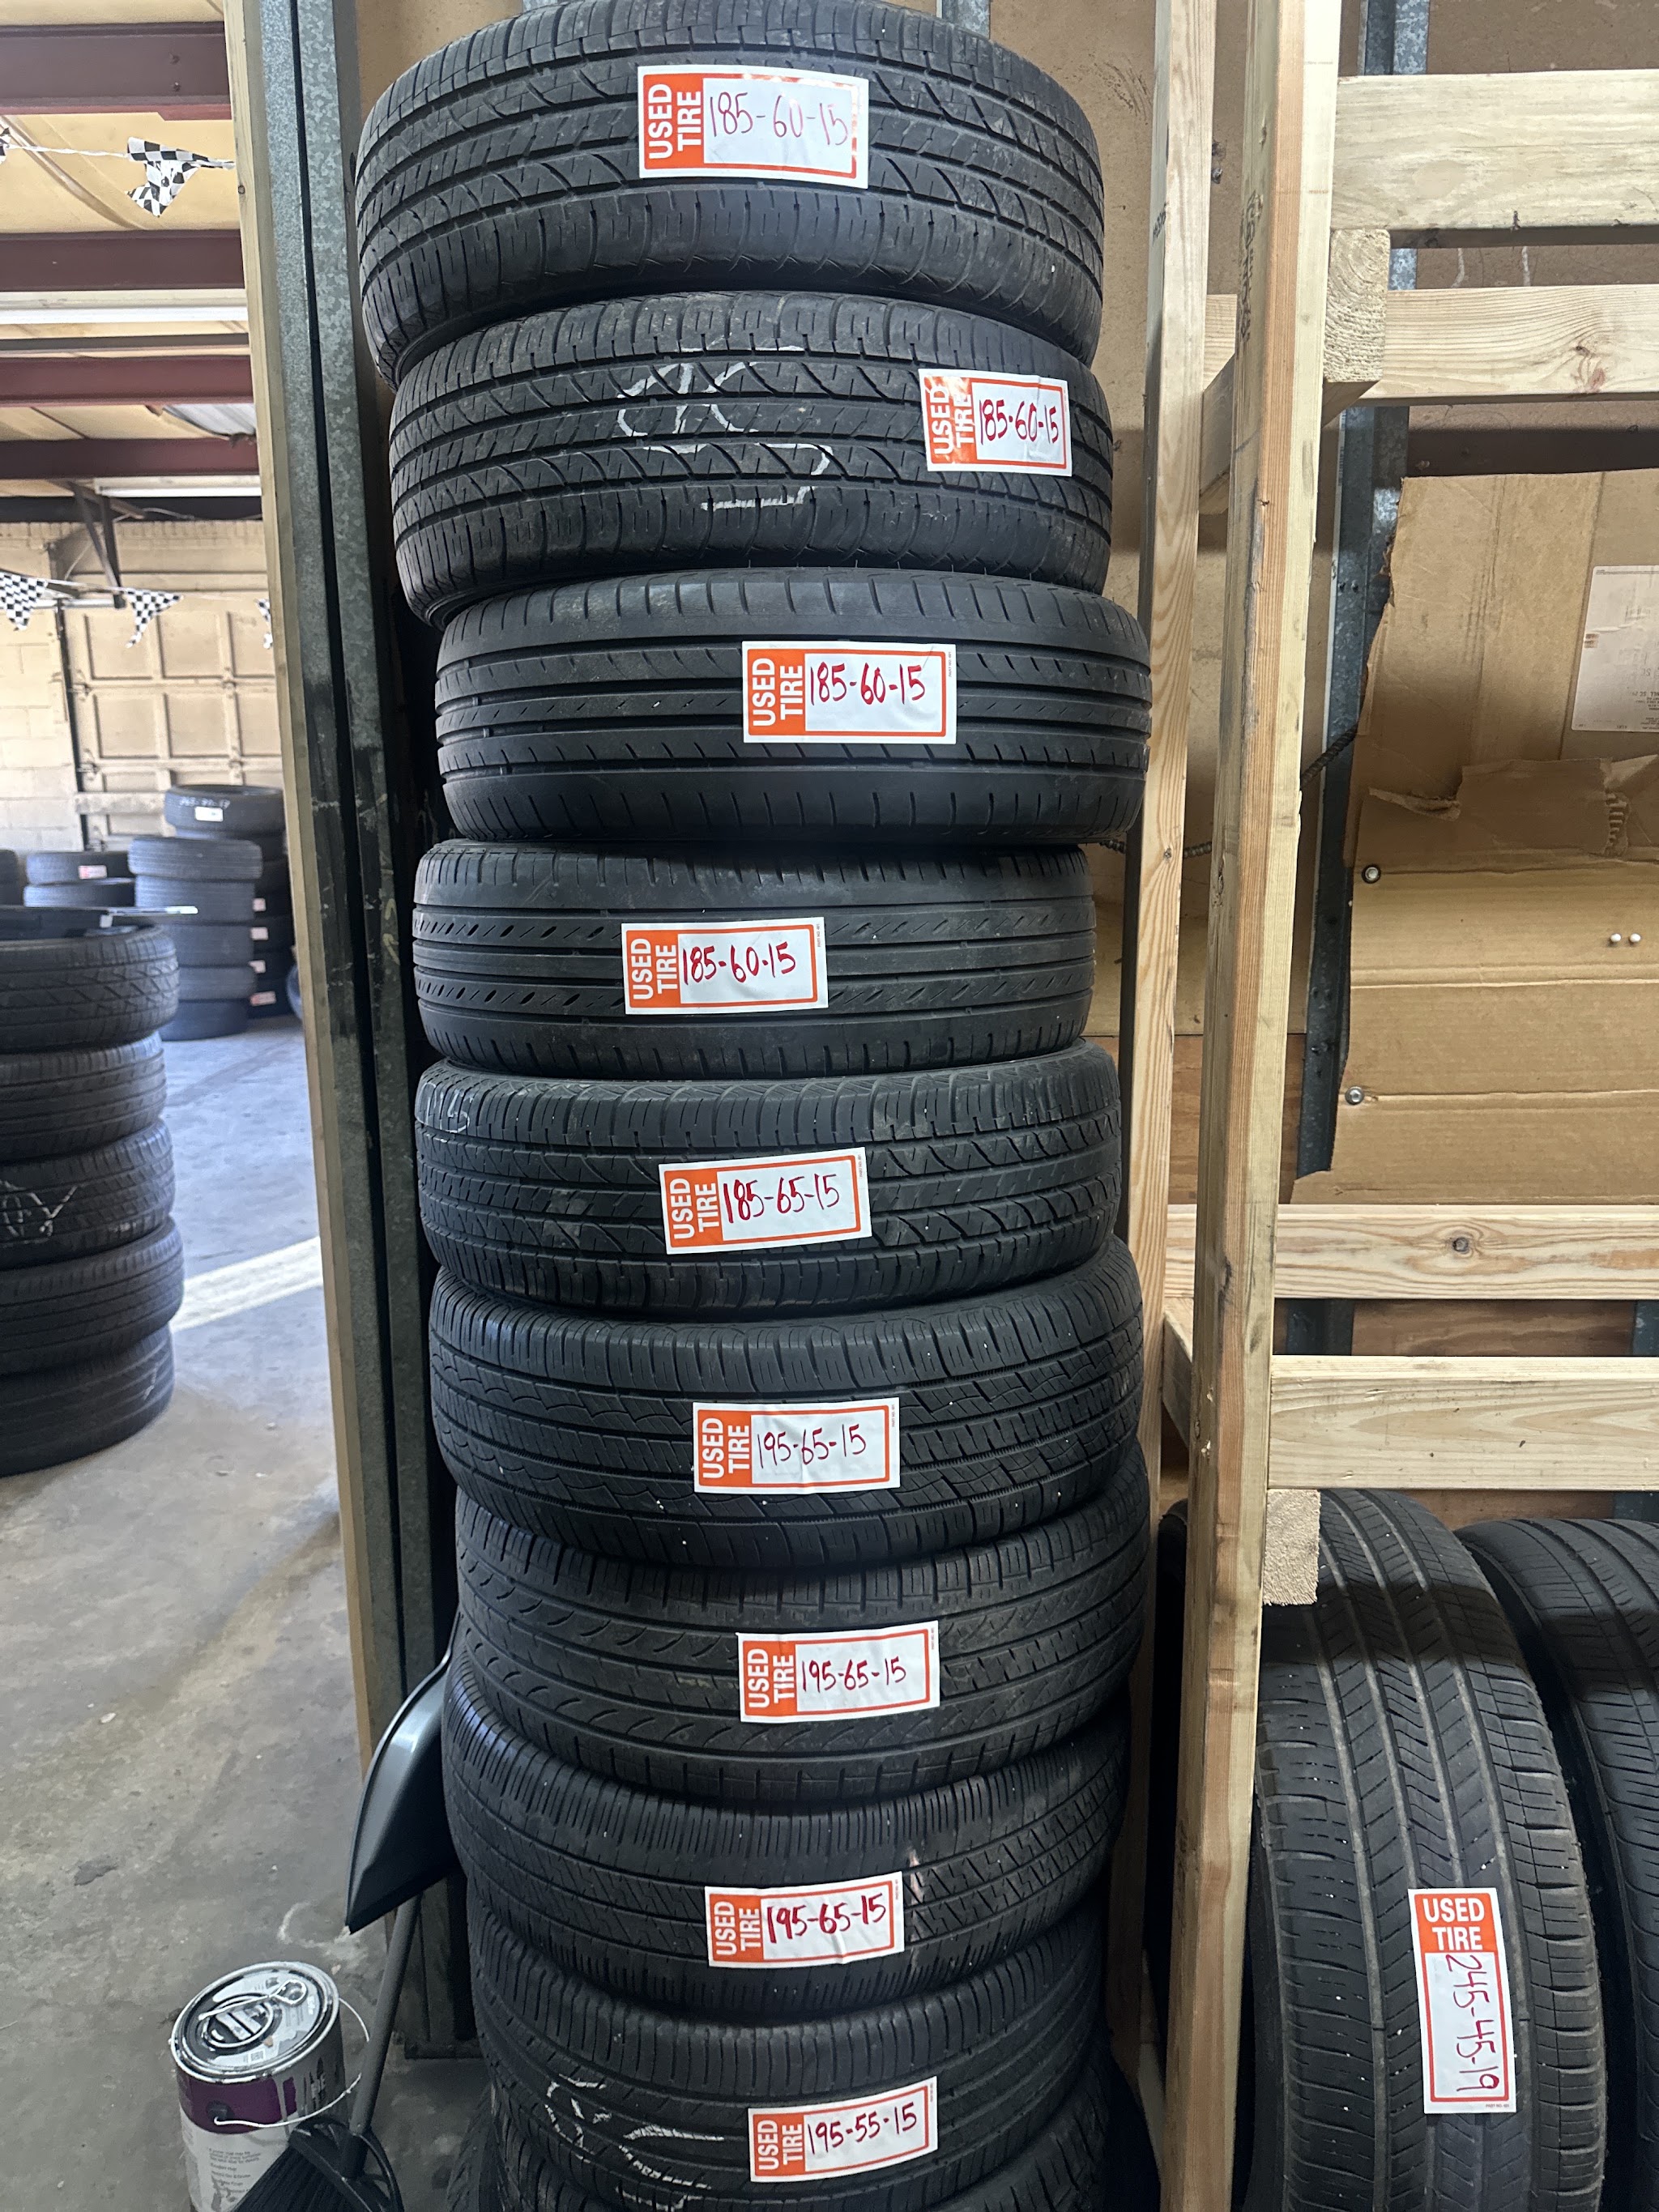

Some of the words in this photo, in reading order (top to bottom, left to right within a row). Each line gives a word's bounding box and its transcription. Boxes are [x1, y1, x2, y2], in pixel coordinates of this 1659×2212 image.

[648, 83, 672, 159] USED
[677, 91, 702, 151] TIRE
[710, 92, 849, 145] 185-60-15
[929, 385, 953, 455] USED
[953, 394, 975, 449] TIRE
[979, 399, 1059, 445] 185-60-15
[752, 658, 776, 727] USED
[779, 665, 804, 721] TIRE
[810, 661, 925, 705] 185-60-15
[630, 938, 654, 1000] USED
[655, 944, 678, 995] TIRE
[683, 941, 796, 986] 185-60-15
[669, 1178, 695, 1240] USED
[695, 1183, 720, 1233] TIRE
[723, 1174, 840, 1224] 185-65-15
[702, 1417, 725, 1479] USED
[727, 1425, 750, 1474] TIRE
[757, 1423, 867, 1469] 195-65-15
[747, 1648, 770, 1708] USED
[773, 1654, 795, 1704] TIRE
[802, 1656, 906, 1693] 195-65-15
[714, 1901, 737, 1956] USED
[739, 1907, 761, 1951] TIRE
[766, 1892, 887, 1944] 195-65-15
[1422, 1897, 1485, 1923] USED
[1431, 1926, 1483, 1951] TIRE
[1445, 1954, 1499, 2092] 245-45-19
[757, 2119, 779, 2171] USED
[782, 2123, 804, 2166] TIRE
[807, 2102, 917, 2155] 195-55-15
